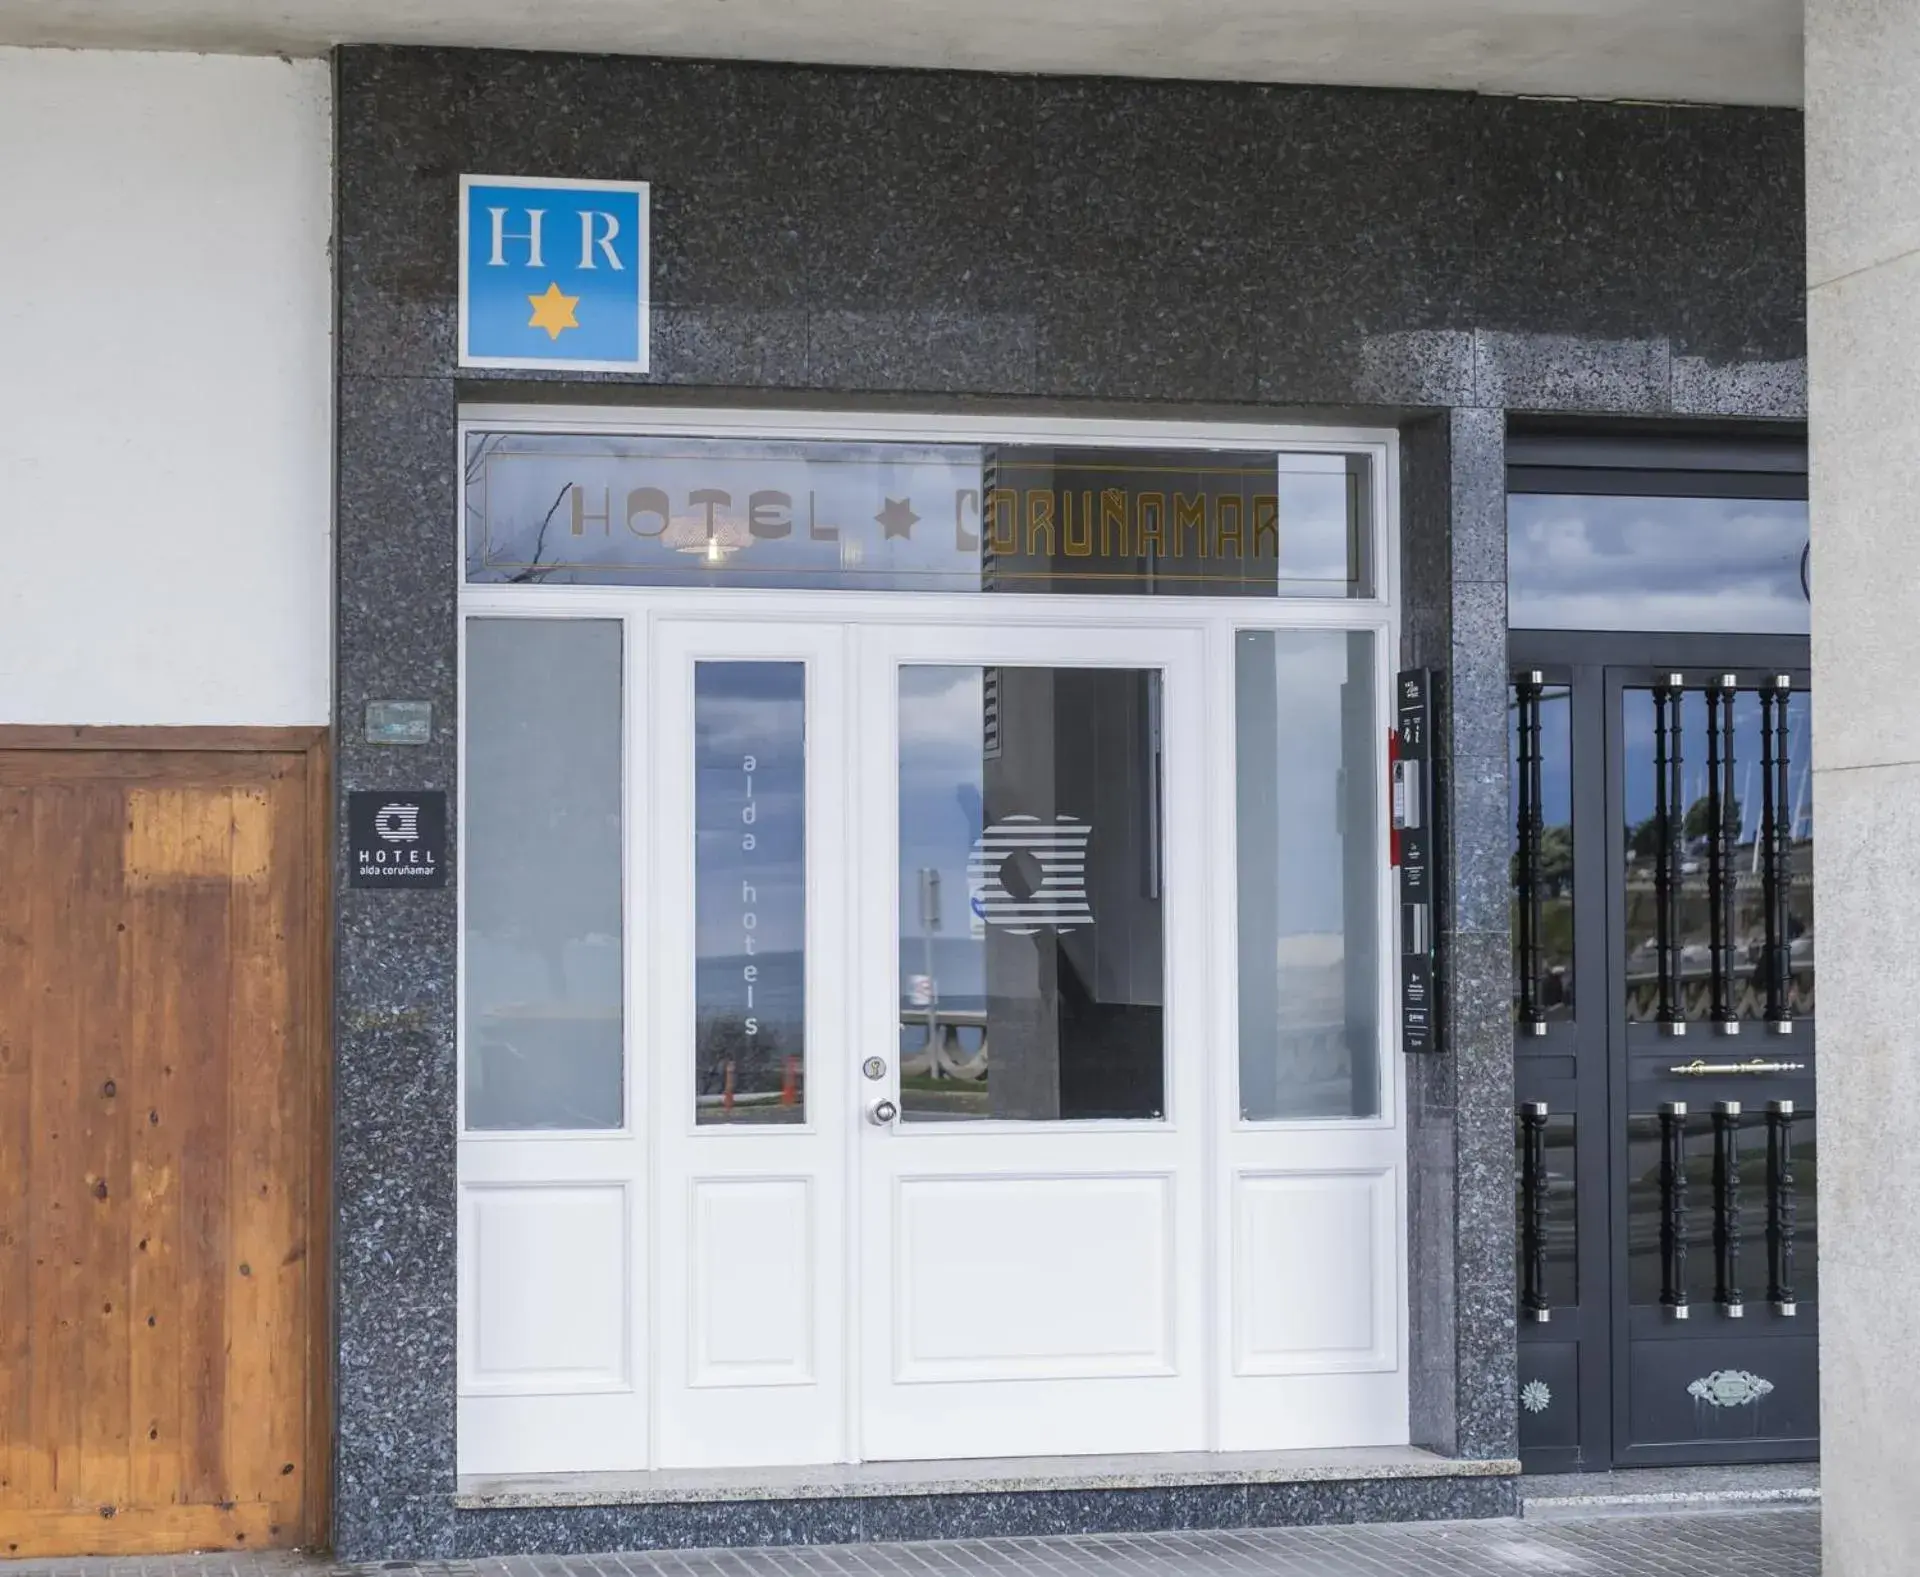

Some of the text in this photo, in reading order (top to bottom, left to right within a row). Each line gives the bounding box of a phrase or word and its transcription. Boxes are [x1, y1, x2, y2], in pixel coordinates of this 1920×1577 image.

[571, 486, 1279, 559] HOTEL CORUÑAMAR
[359, 850, 435, 863] HOTEL
[359, 865, 436, 875] alda coruñamar
[742, 755, 758, 1035] alda hotels
